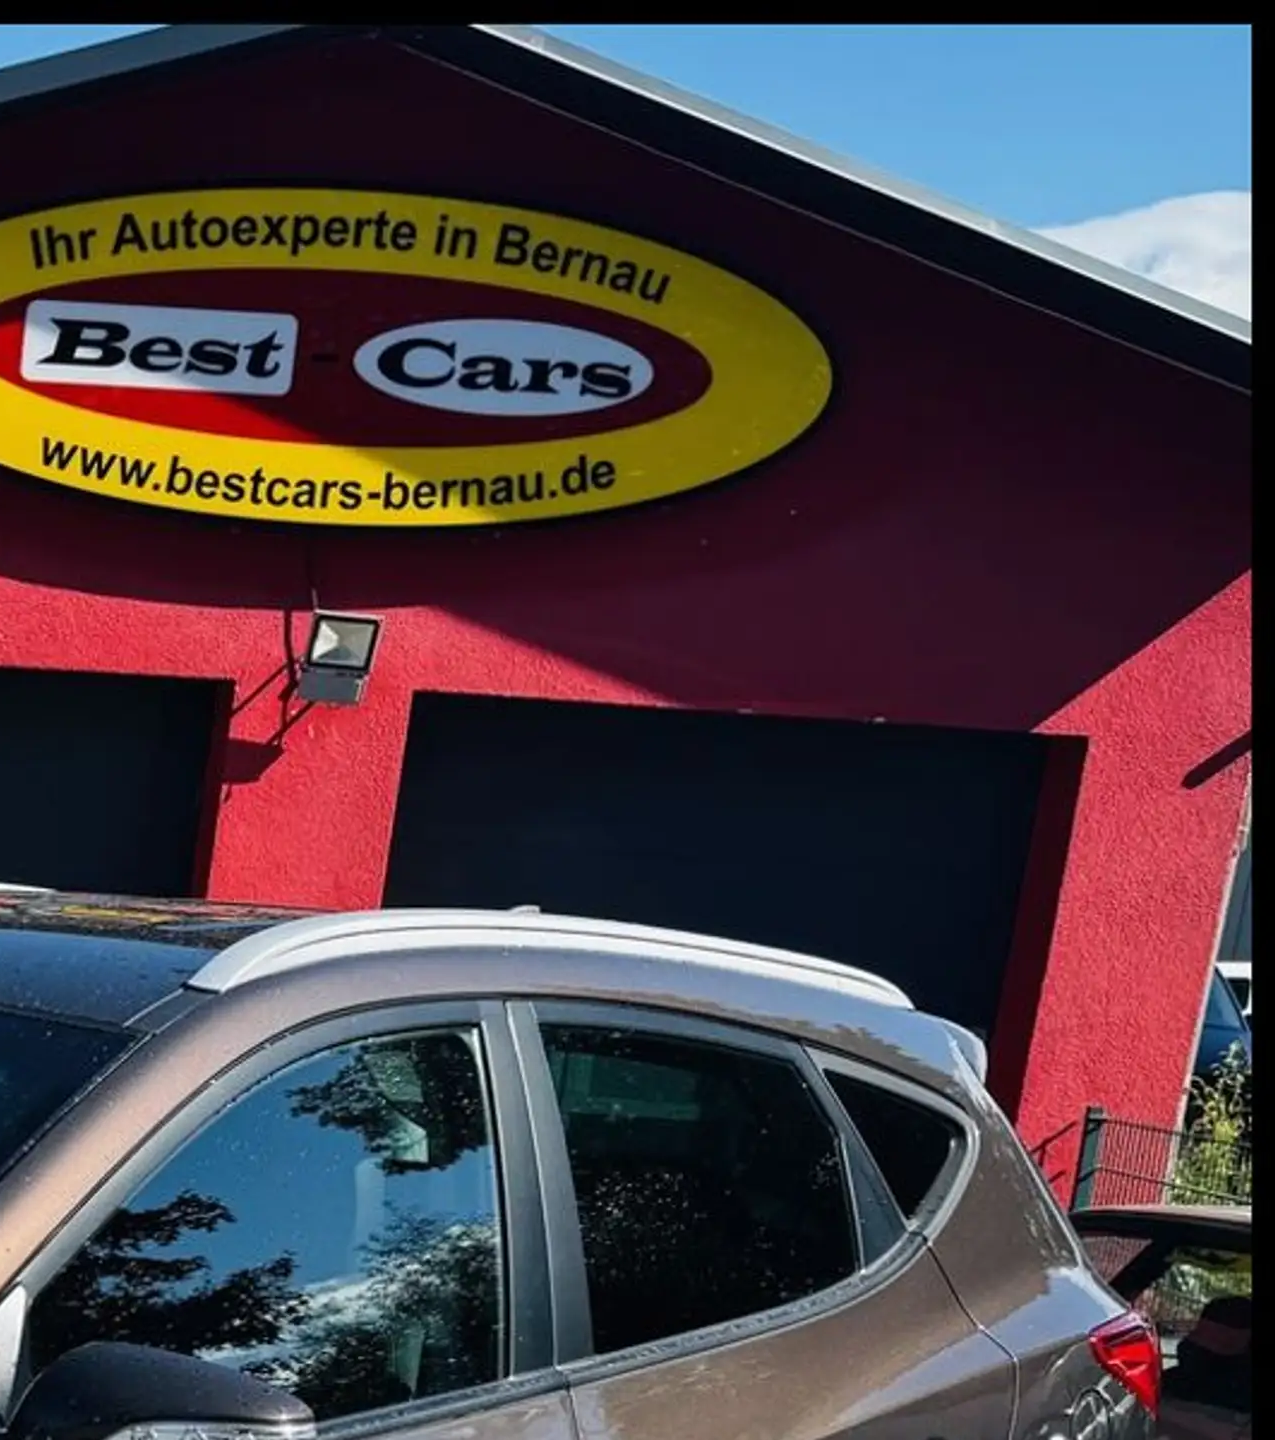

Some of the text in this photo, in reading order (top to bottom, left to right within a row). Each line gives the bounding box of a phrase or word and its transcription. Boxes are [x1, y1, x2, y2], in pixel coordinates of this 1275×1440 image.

[29, 204, 671, 304] Ihr Autoexperte in Bernau
[36, 316, 284, 378] Best
[377, 338, 633, 398] Cars
[41, 435, 616, 510] www.bestcars-bernau.de
